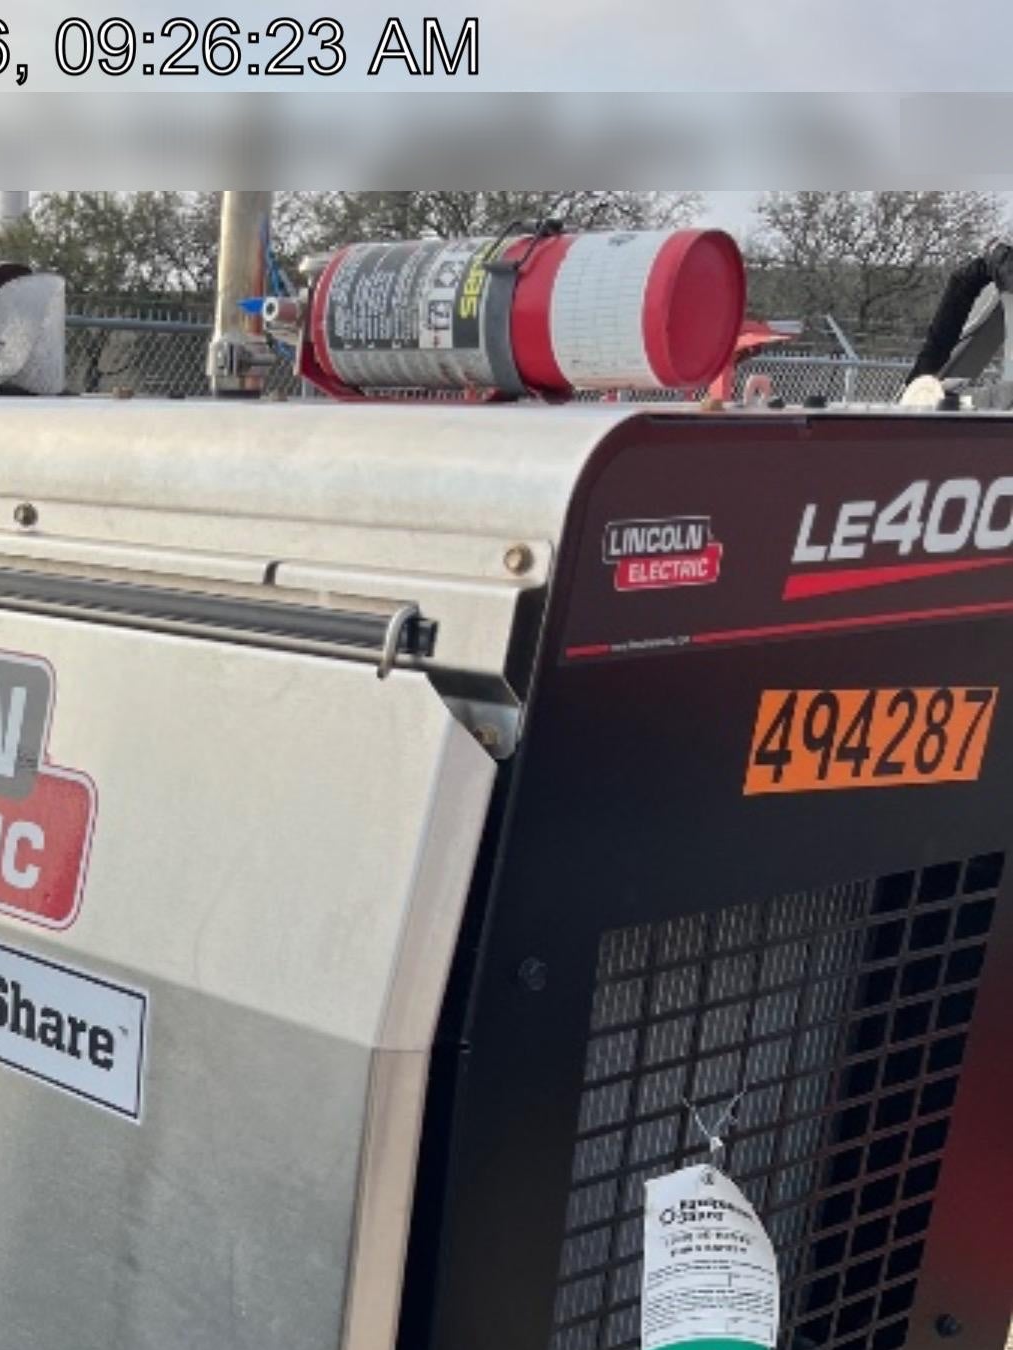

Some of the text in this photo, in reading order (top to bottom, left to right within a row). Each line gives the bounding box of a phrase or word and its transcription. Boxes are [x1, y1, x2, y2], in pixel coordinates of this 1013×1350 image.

[609, 524, 704, 556] LINCOLN
[791, 476, 1013, 564] LE400
[628, 557, 709, 583] ELECTRIC
[755, 688, 994, 784] 494287
